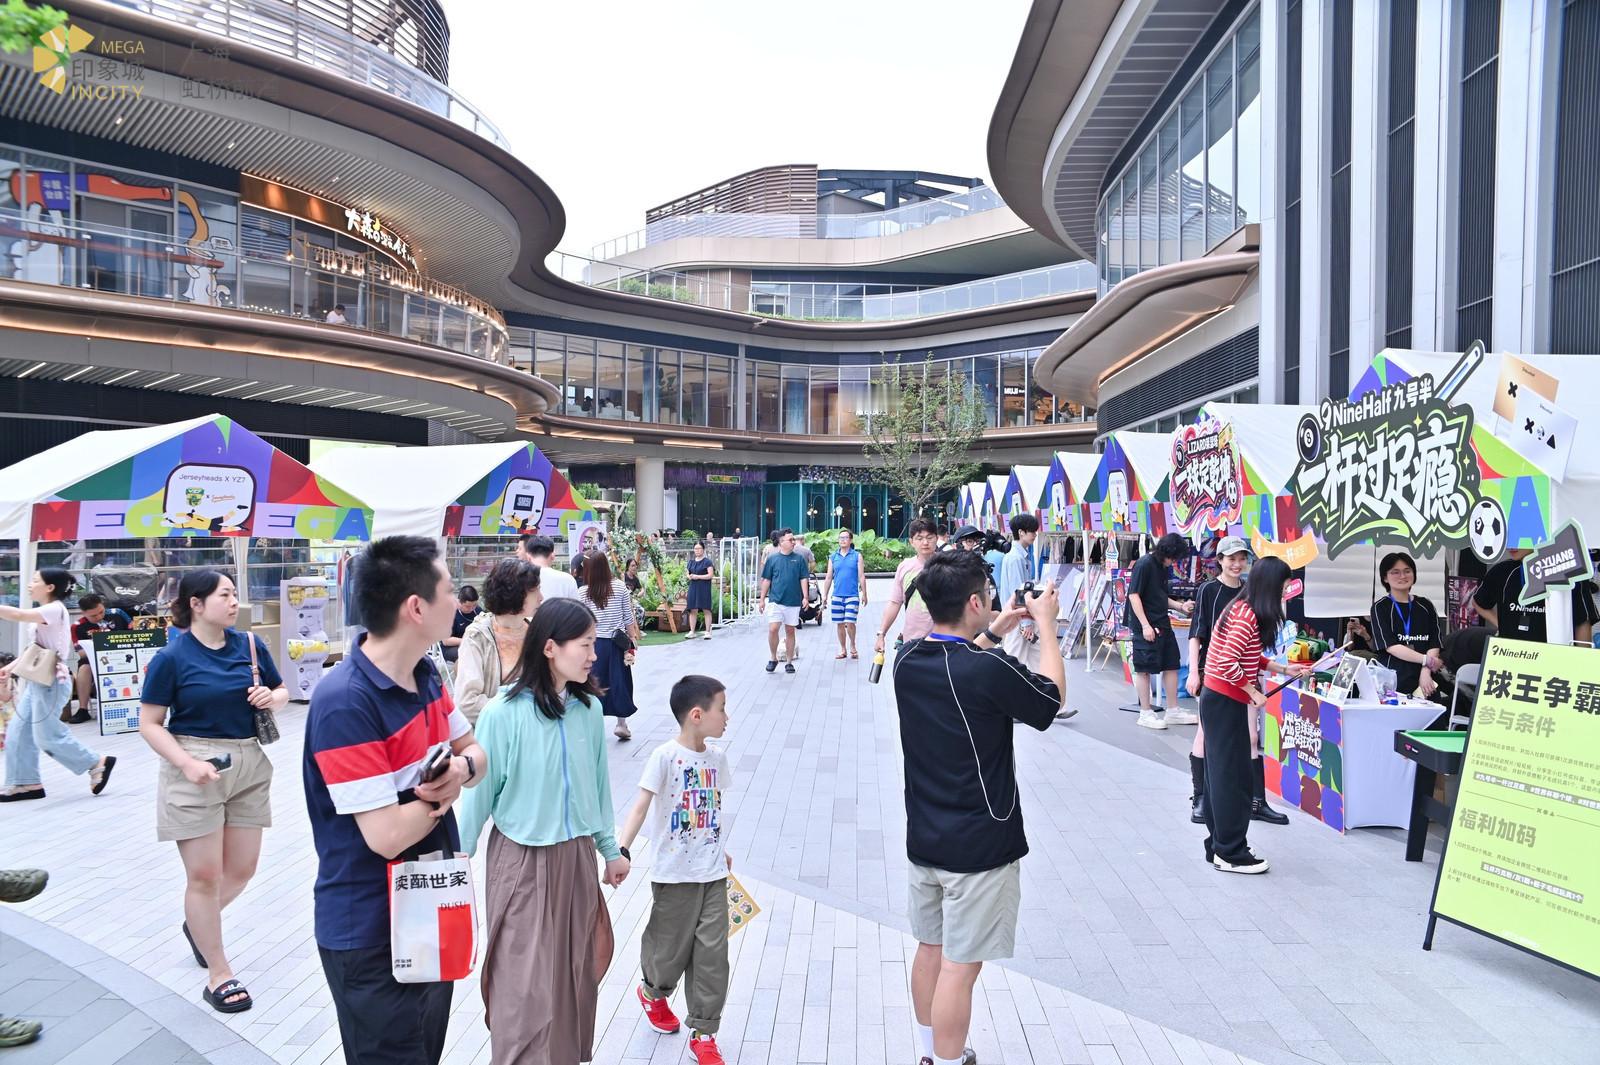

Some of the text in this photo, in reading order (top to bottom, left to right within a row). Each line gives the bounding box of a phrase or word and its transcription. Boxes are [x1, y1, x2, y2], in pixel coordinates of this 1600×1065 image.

[1393, 378, 1433, 411] 九号半
[179, 474, 222, 482] Jerseyheads
[1297, 417, 1468, 537] 一杆过足瘾
[1542, 548, 1575, 566] YUAN8
[1483, 669, 1600, 716] 球王争霸
[1478, 705, 1557, 738] 参与条件
[1459, 807, 1537, 848] 福利加码
